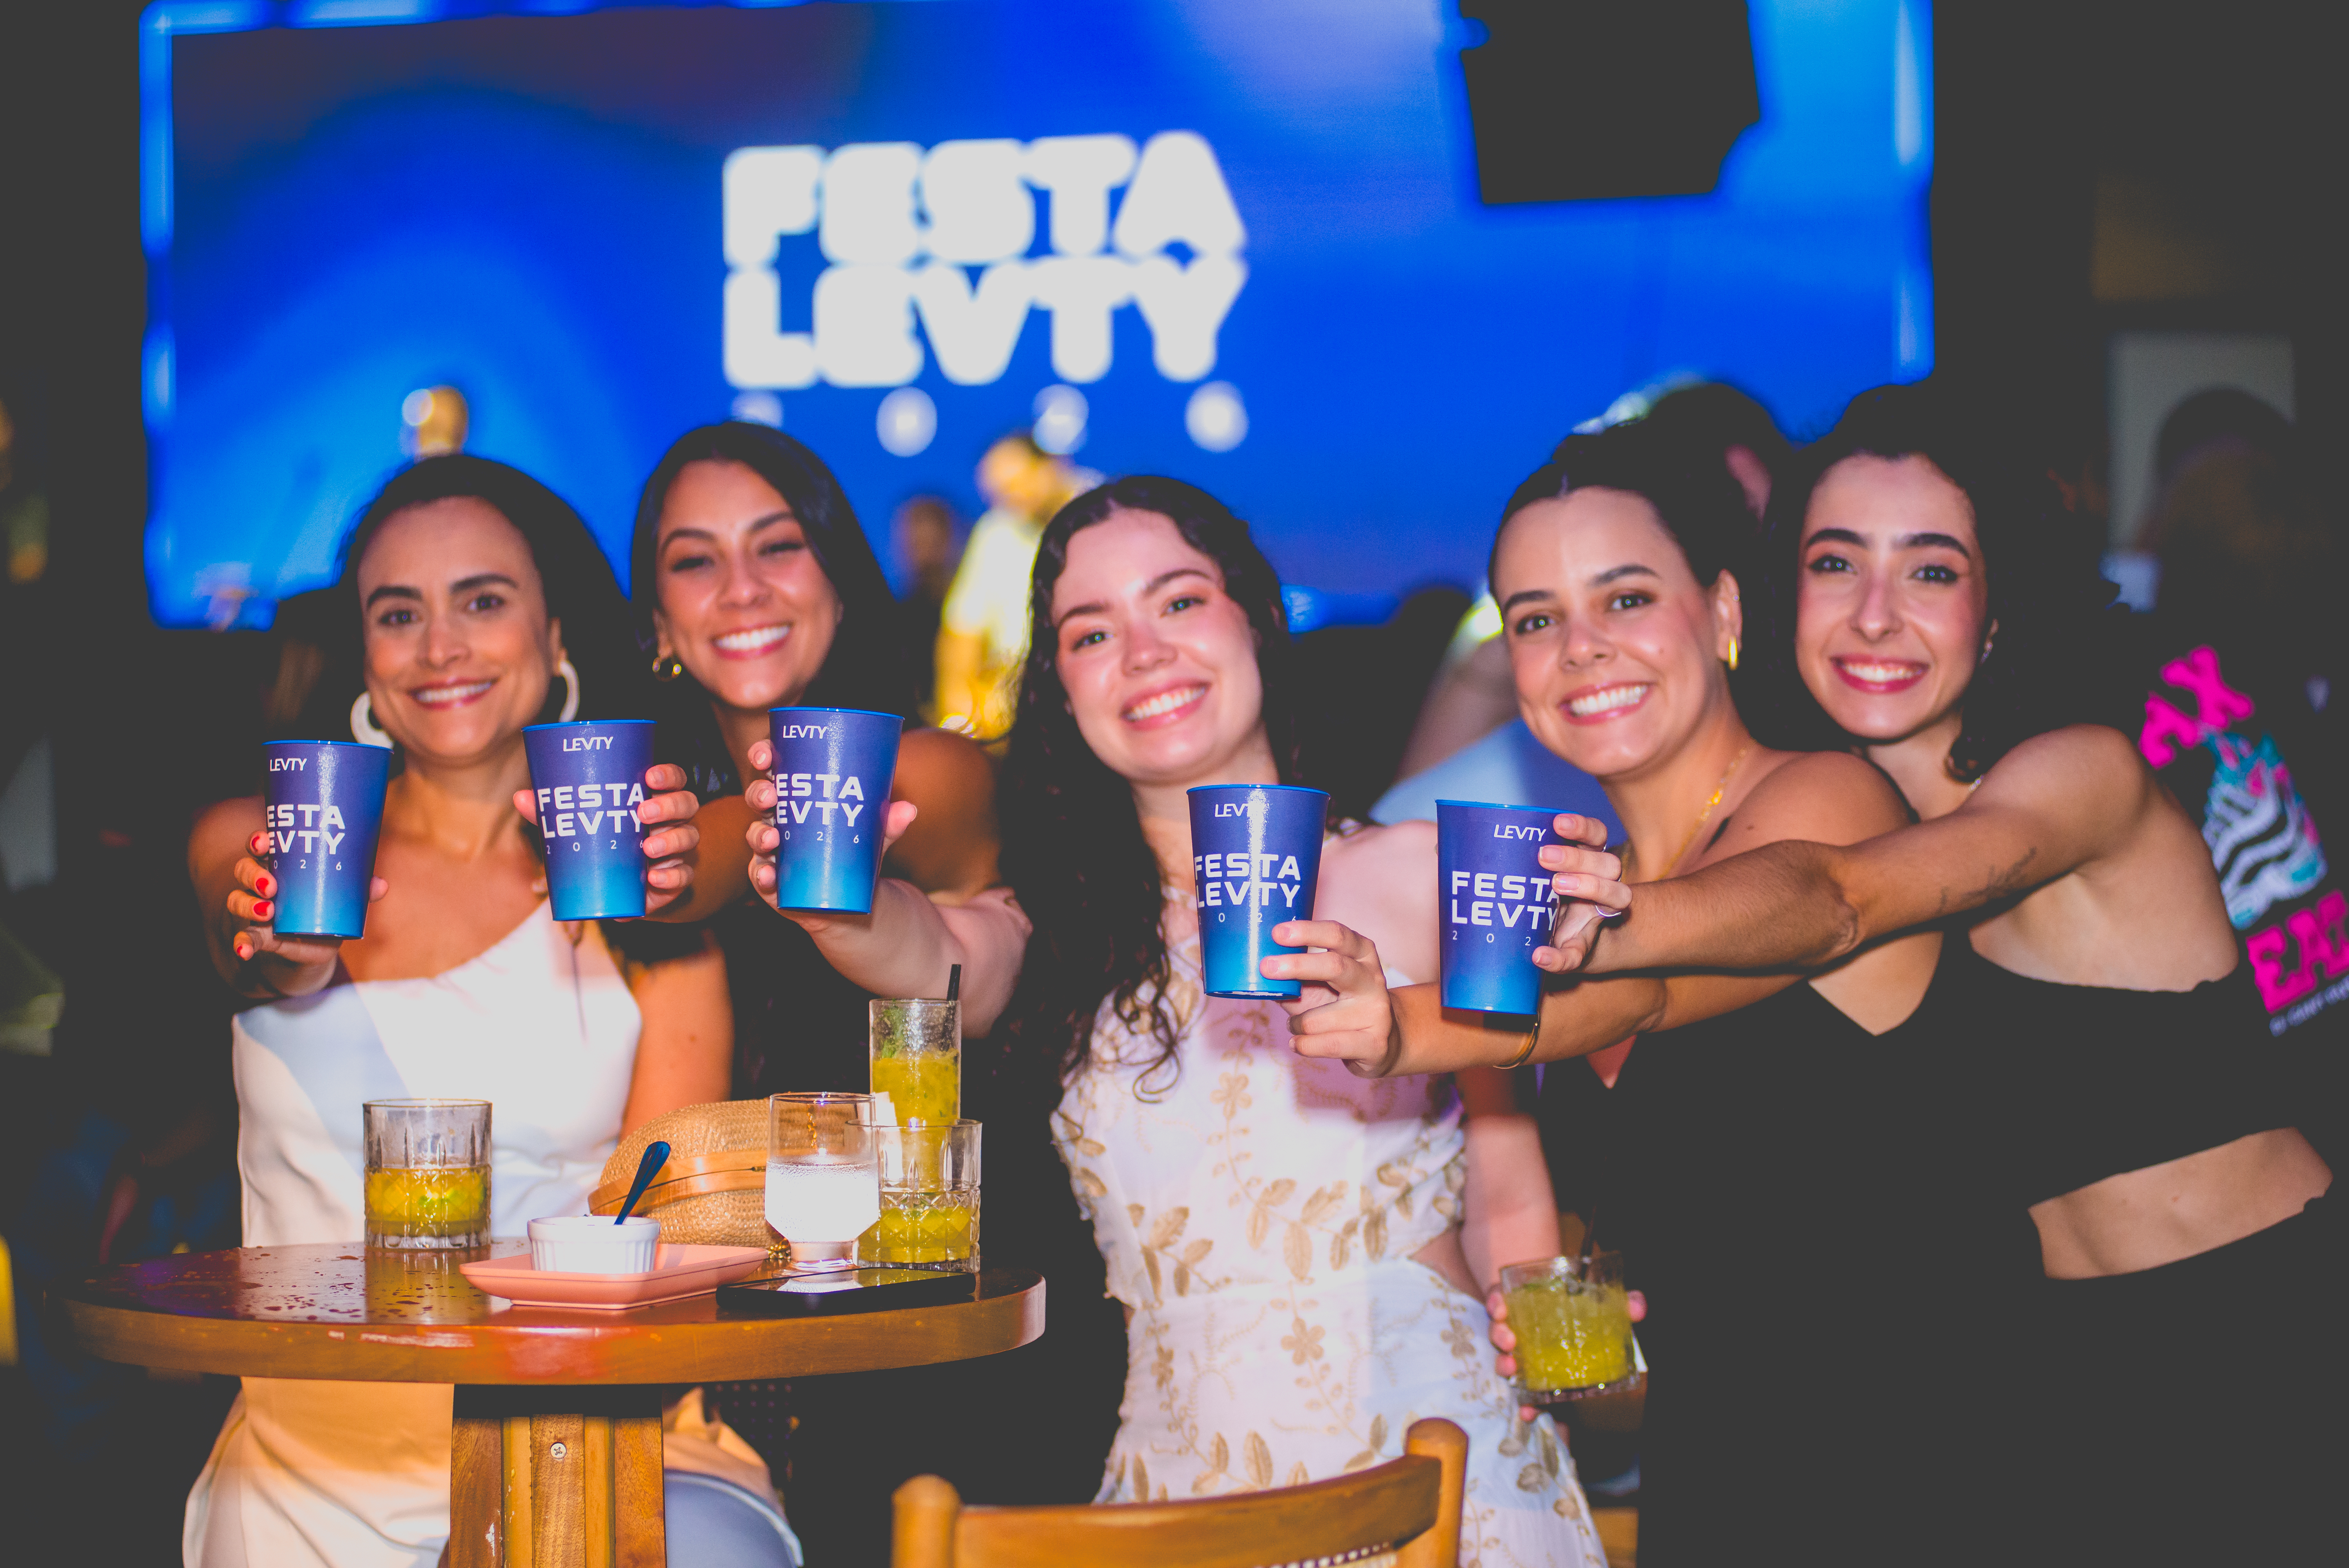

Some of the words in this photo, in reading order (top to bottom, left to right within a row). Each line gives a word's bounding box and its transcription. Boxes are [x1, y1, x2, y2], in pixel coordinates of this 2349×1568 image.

[722, 131, 1248, 269] FESTA
[722, 256, 1249, 390] LEVTY
[563, 736, 613, 752] LEVTY
[783, 725, 827, 739] LEVTY
[269, 758, 307, 772] LEVTY
[537, 783, 645, 812] FESTA
[776, 773, 864, 801] ESTA
[267, 804, 346, 830] ESTA
[541, 810, 642, 839] LEVTY
[776, 801, 864, 827] EVTY
[268, 830, 346, 855] EVTY
[1494, 824, 1546, 841] LEVTY
[1194, 853, 1301, 881] FESTA
[1196, 881, 1301, 908] LEVTY
[1452, 871, 1559, 903] FESTA
[1452, 899, 1558, 931] LEVTY
[1452, 930, 1552, 947] 202
